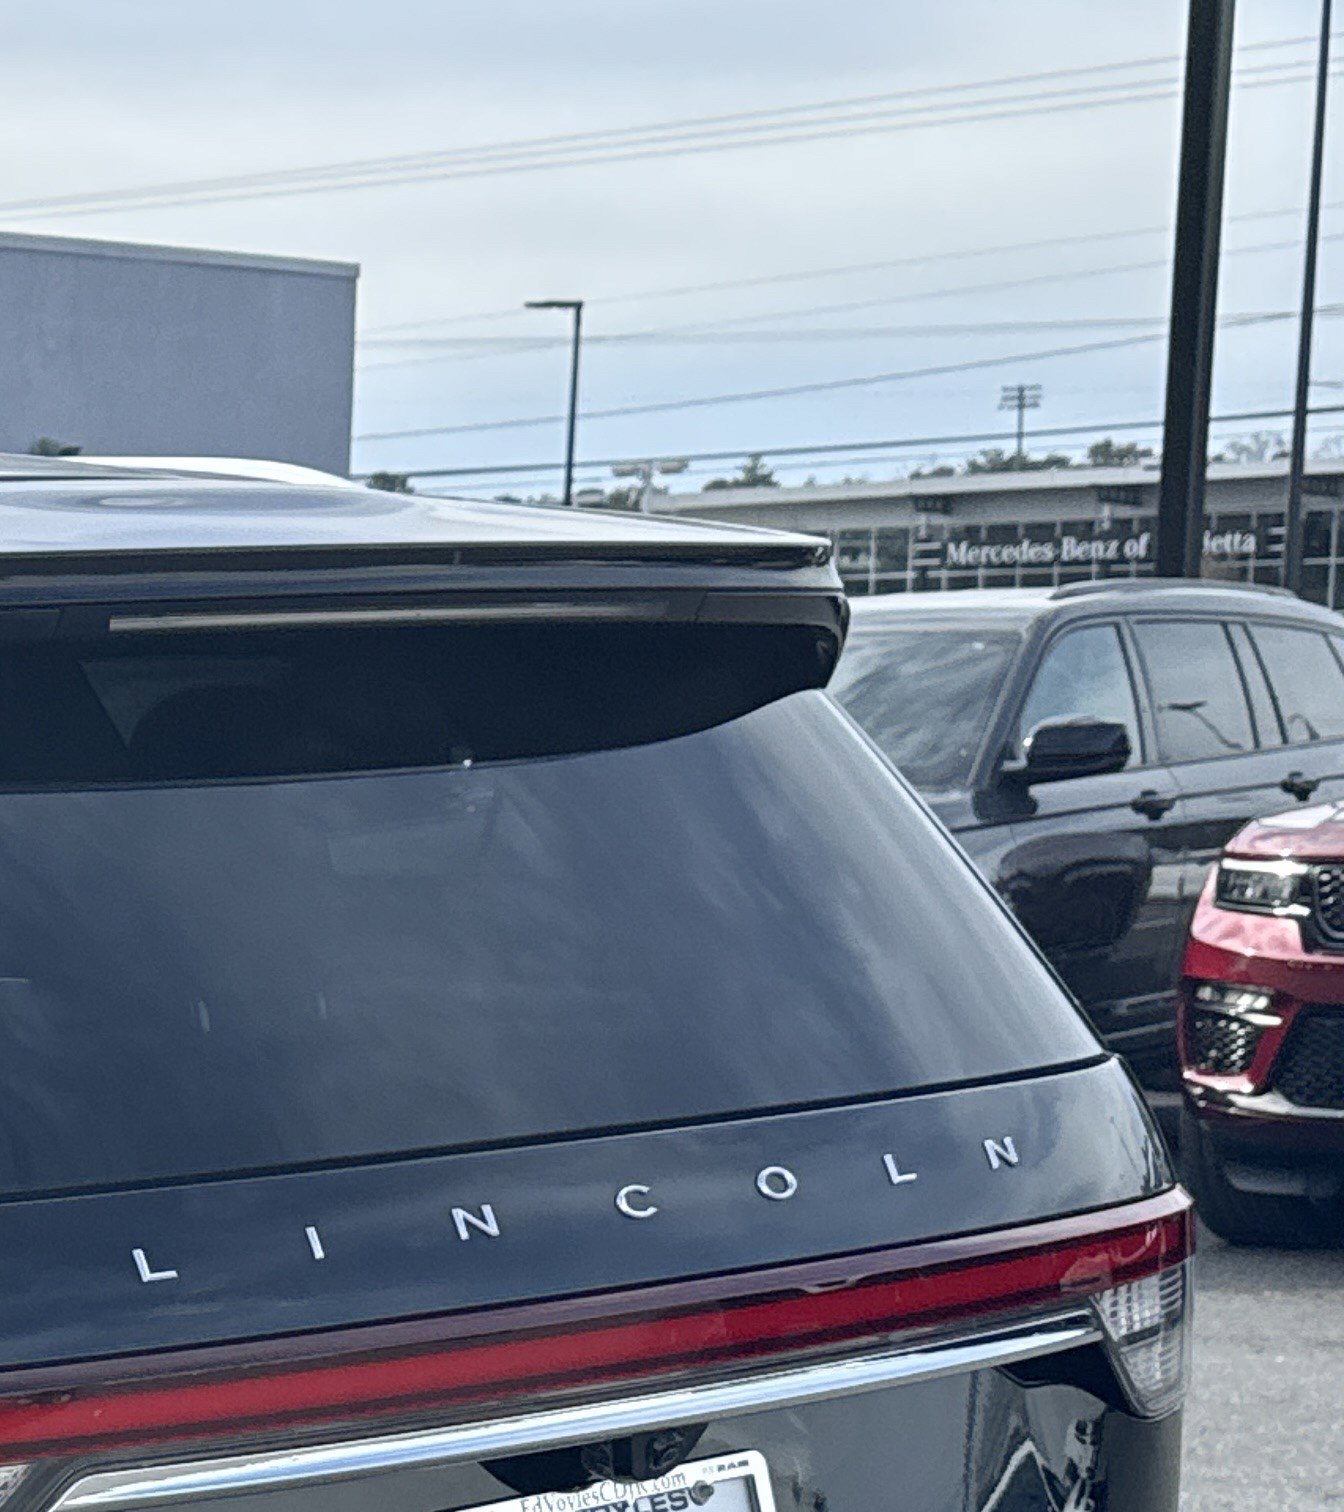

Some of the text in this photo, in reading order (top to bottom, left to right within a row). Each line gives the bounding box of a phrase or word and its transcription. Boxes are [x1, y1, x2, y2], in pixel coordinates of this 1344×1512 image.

[1123, 532, 1151, 559] of
[1202, 530, 1257, 554] ietta
[132, 1135, 1020, 1283] LINCOLN
